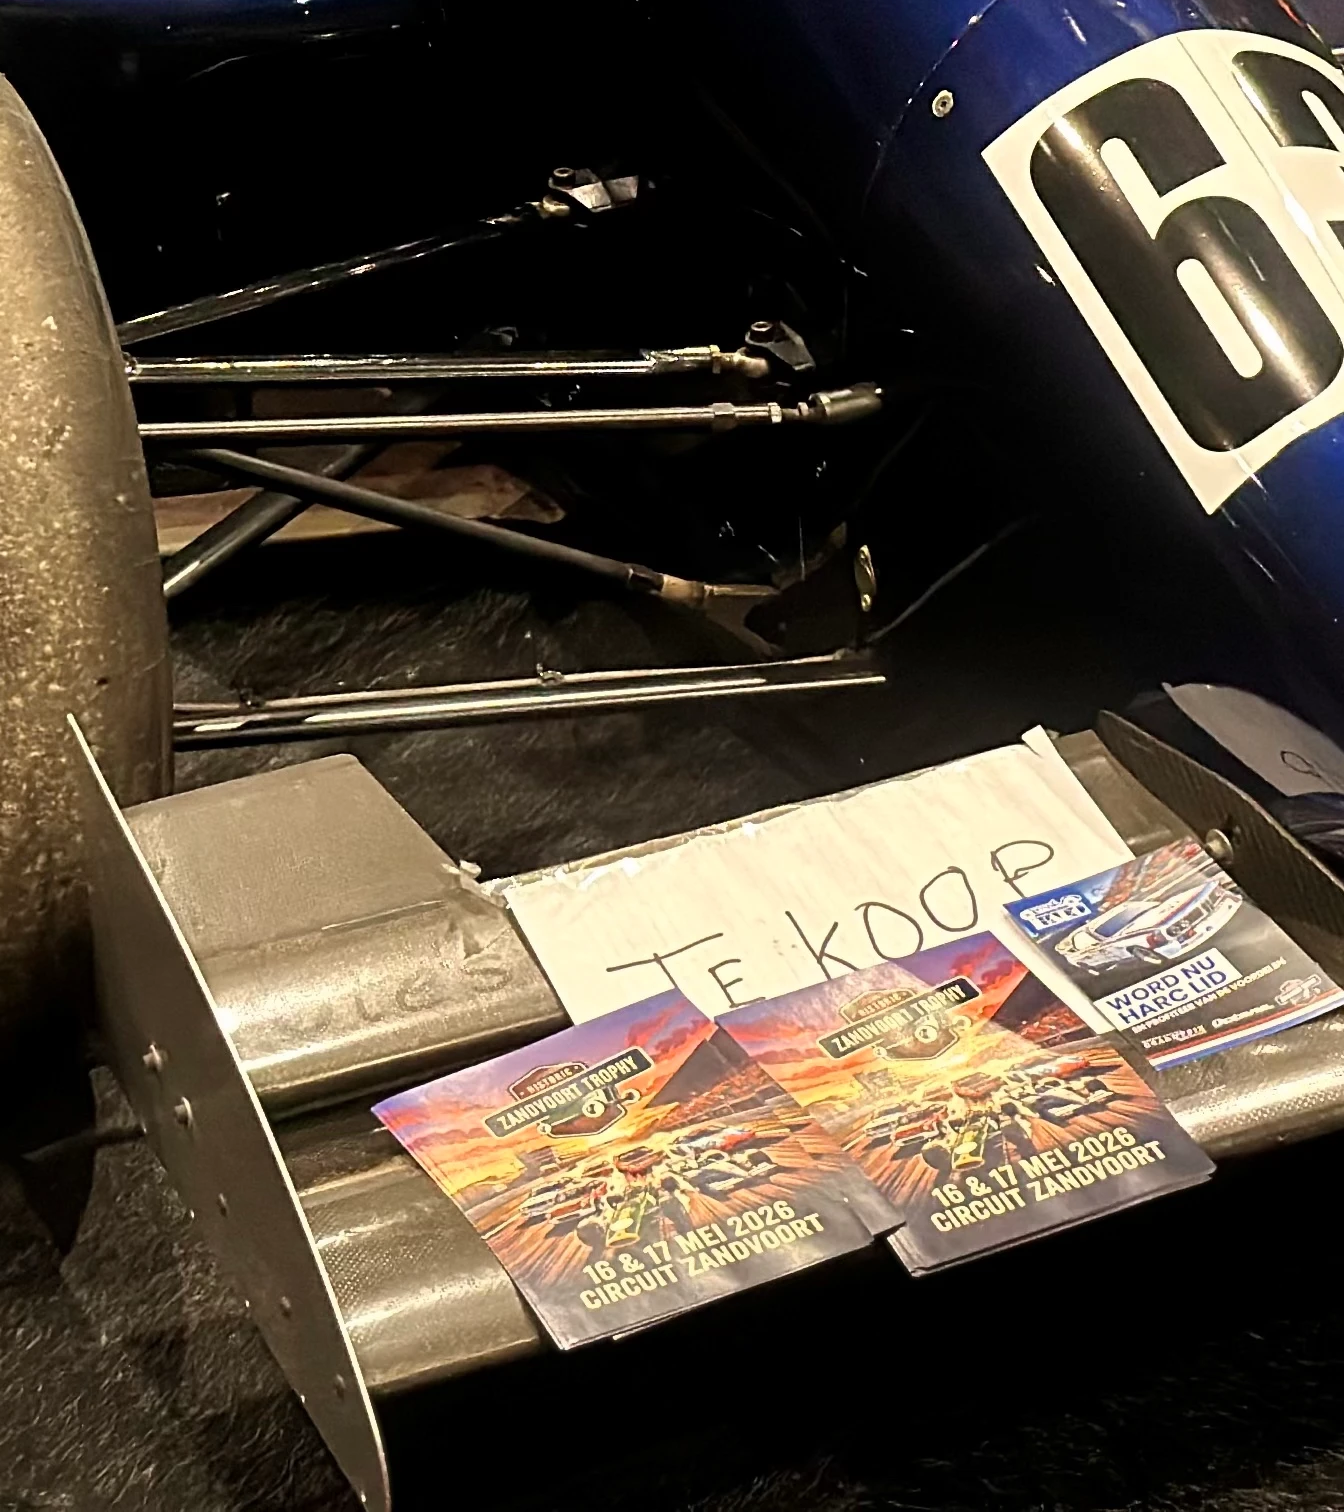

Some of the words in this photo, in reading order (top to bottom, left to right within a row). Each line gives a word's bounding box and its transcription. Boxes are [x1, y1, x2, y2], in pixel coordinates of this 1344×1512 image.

[606, 932, 766, 1008] TE
[786, 839, 1054, 981] KOOP
[831, 1007, 911, 1051] ZANDVOORT
[910, 984, 967, 1016] TROPHY
[1105, 974, 1180, 1011] WORD
[1181, 956, 1216, 979] NU
[1117, 990, 1188, 1024] HARC
[1188, 970, 1227, 994] LID
[497, 1083, 582, 1130] ZANDVOORT
[581, 1056, 637, 1091] TROPHY
[930, 1188, 1027, 1232] CIRCUIT
[1027, 1141, 1166, 1201] ZANDVOORT
[932, 1183, 964, 1207] 16
[966, 1176, 993, 1197] &
[991, 1165, 1018, 1189] 17
[1019, 1147, 1069, 1179] MEI
[1069, 1127, 1135, 1162] 2026
[580, 1264, 679, 1310] CIRCUIT
[680, 1213, 825, 1275] ZANDVOORT
[583, 1259, 616, 1285] 16
[619, 1251, 646, 1273] &
[643, 1240, 673, 1266] 17
[674, 1222, 727, 1254] MEI
[728, 1200, 795, 1234] 2026
